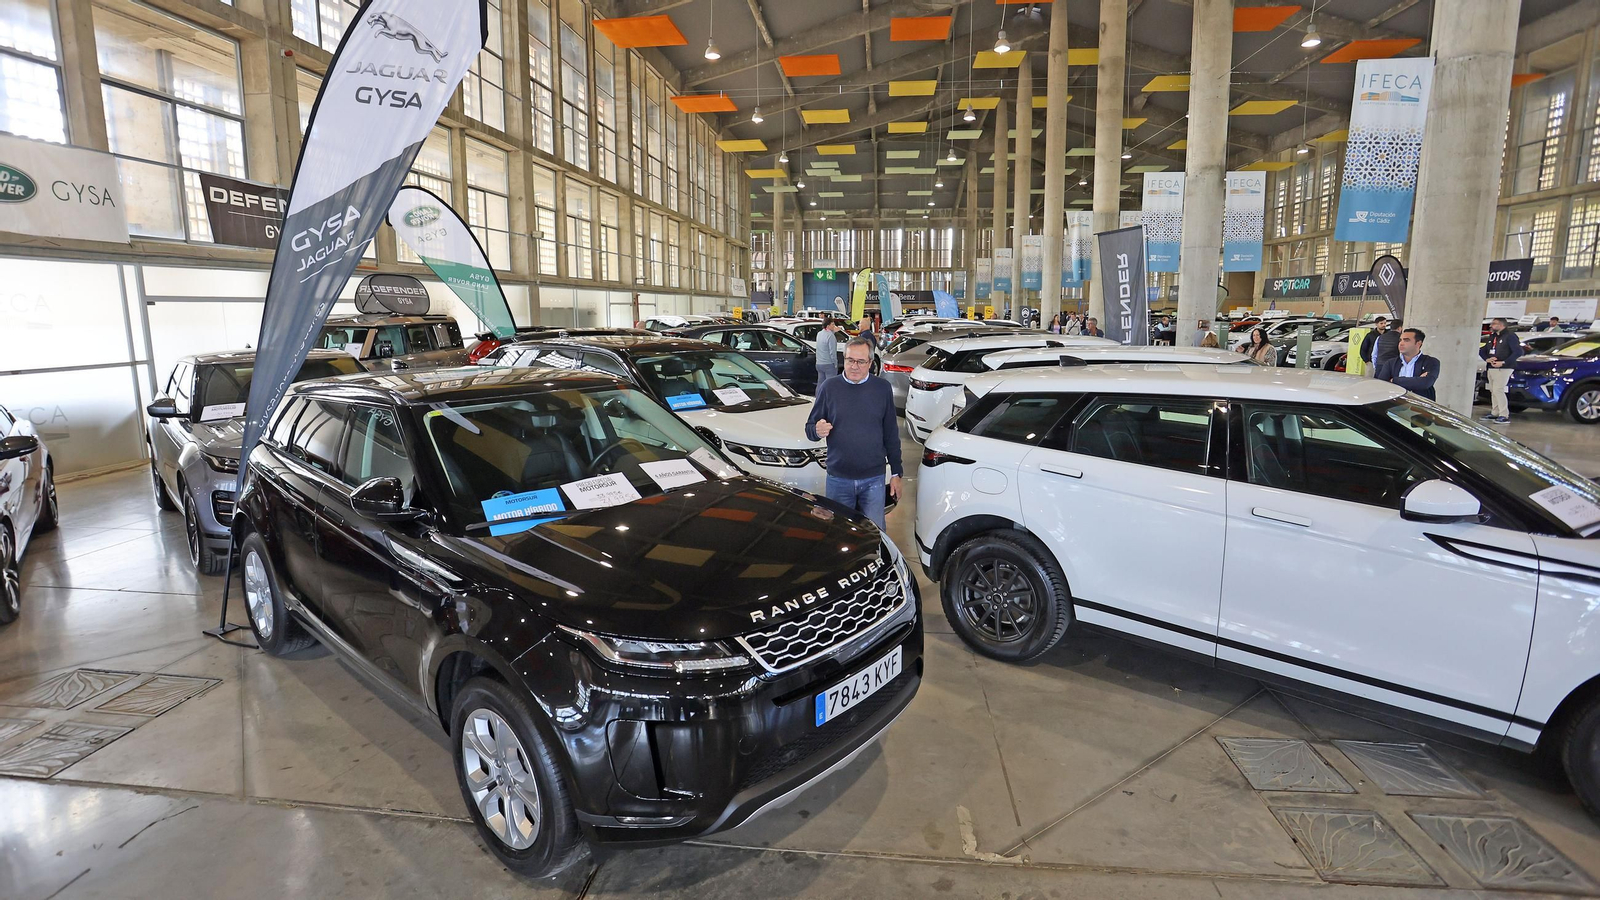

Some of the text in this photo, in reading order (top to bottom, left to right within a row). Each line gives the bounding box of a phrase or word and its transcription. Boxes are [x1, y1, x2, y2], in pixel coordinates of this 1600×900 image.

[346, 62, 448, 84] JAGUAR
[1361, 73, 1422, 90] IFECA
[355, 86, 423, 110] GYSA
[1148, 179, 1180, 189] IFECA
[1230, 178, 1262, 188] IFECA
[52, 180, 116, 208] GYSA
[291, 205, 361, 252] GYSA
[1488, 270, 1522, 282] OTORS
[372, 285, 428, 297] DEFENDER
[397, 296, 414, 305] GYSA
[579, 480, 617, 493] MOTORSUR
[505, 494, 539, 505] MOTORSUR
[493, 509, 524, 520] MOTOR
[750, 557, 885, 624] RANGE ROVER
[828, 651, 899, 716] 7843 KYF
